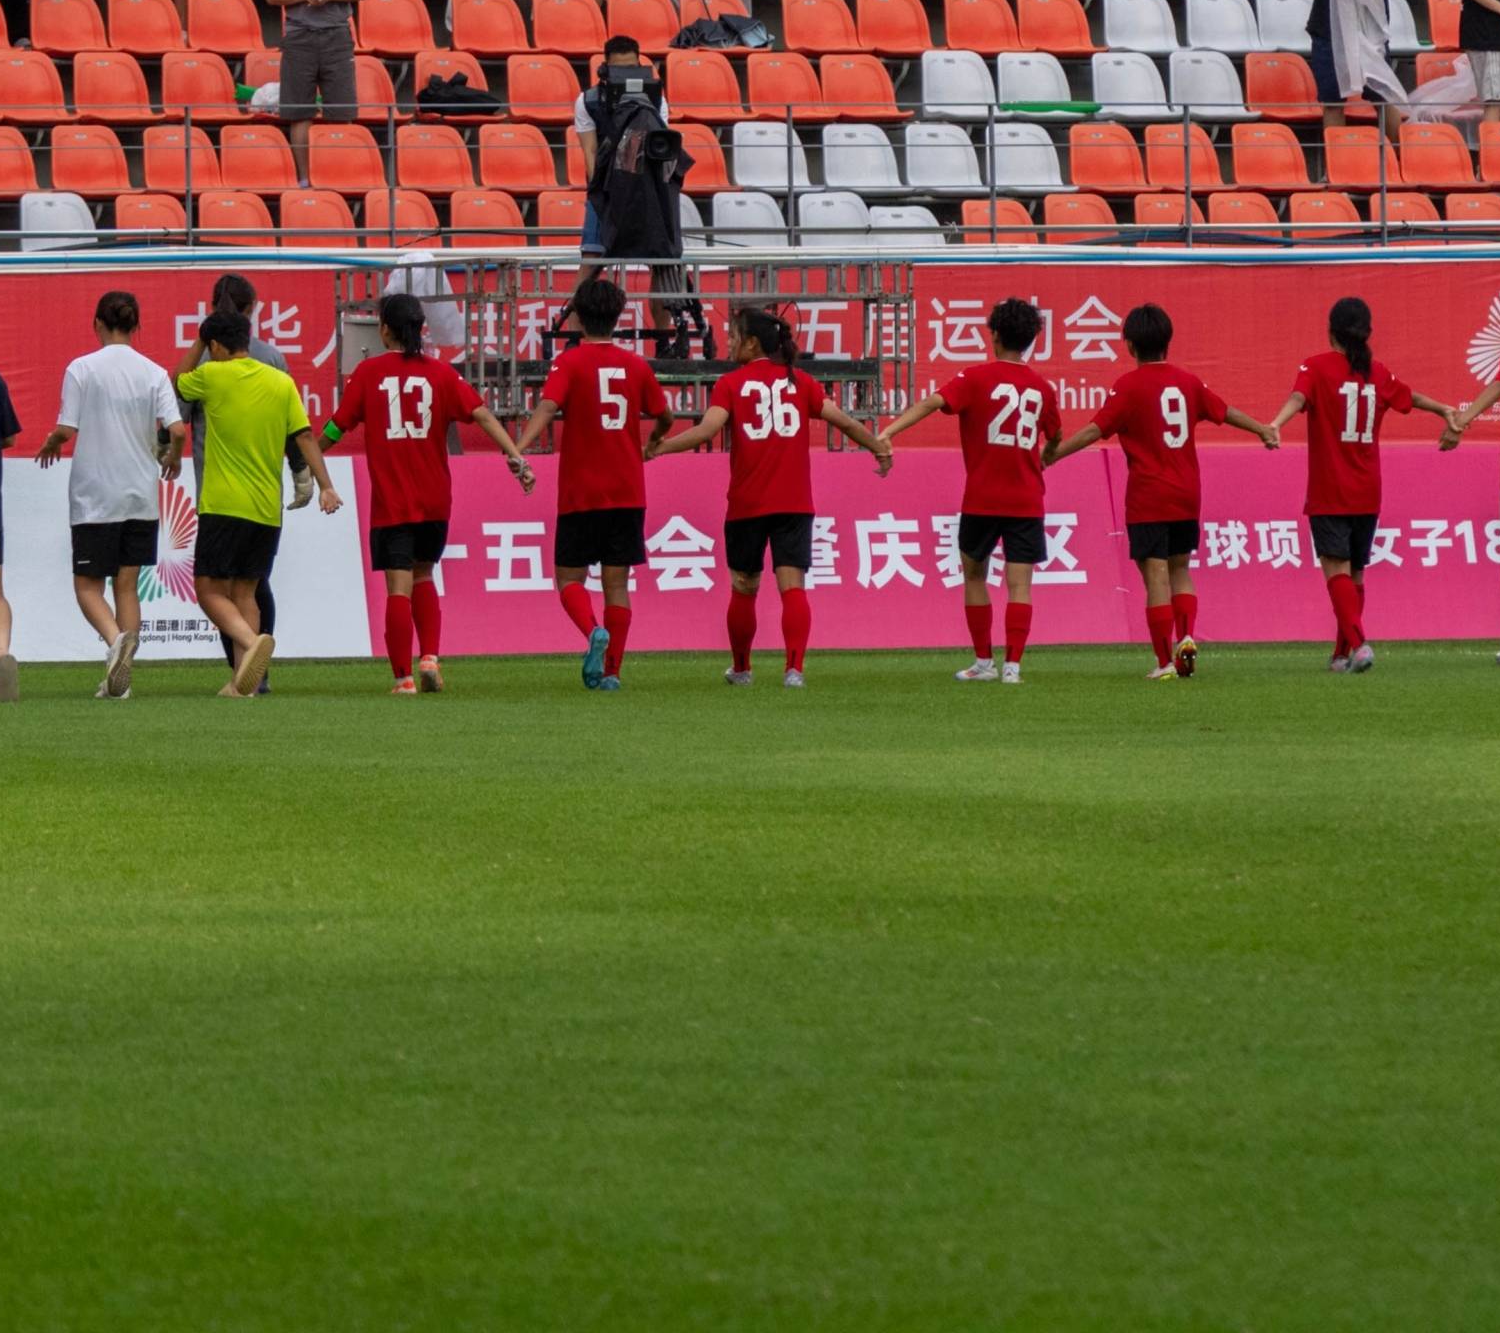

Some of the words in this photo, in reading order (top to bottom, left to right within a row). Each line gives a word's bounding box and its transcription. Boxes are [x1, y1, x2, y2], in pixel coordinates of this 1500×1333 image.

[378, 376, 433, 439] 13
[597, 367, 628, 431] 5
[740, 378, 801, 438] 36
[987, 383, 1043, 451] 28
[1161, 386, 1188, 449] 9
[1339, 381, 1376, 443] 11
